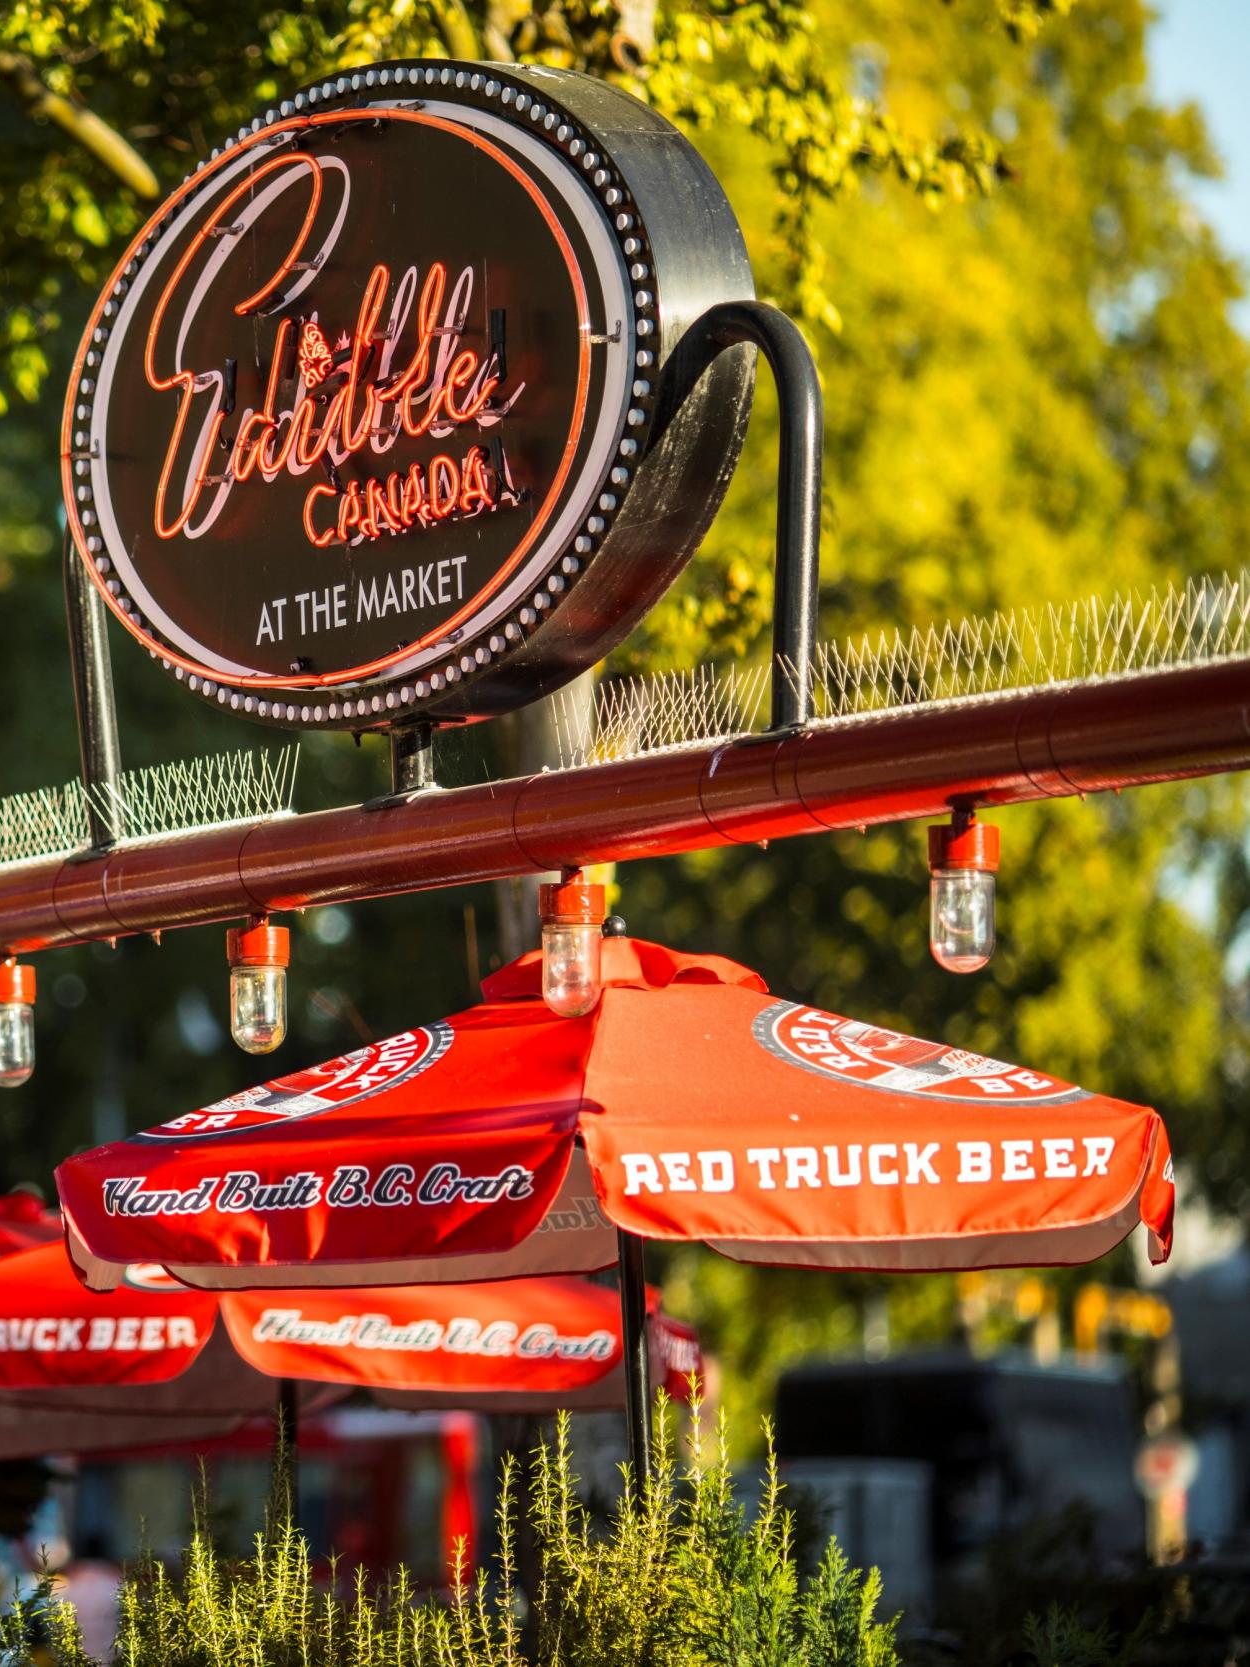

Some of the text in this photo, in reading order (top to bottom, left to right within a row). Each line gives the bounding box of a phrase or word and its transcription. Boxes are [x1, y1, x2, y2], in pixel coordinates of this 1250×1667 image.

[303, 444, 519, 548] CANADA
[256, 555, 468, 646] AT THE MARKET
[103, 1162, 534, 1216] Hand Built B.C. Craft
[620, 1150, 735, 1196] RED
[747, 1143, 940, 1190] TRUCK
[957, 1137, 1116, 1183] BEER
[86, 1315, 199, 1351] BEER
[253, 1308, 357, 1346] Hand
[351, 1312, 443, 1352] Built
[516, 1322, 617, 1361] Craft
